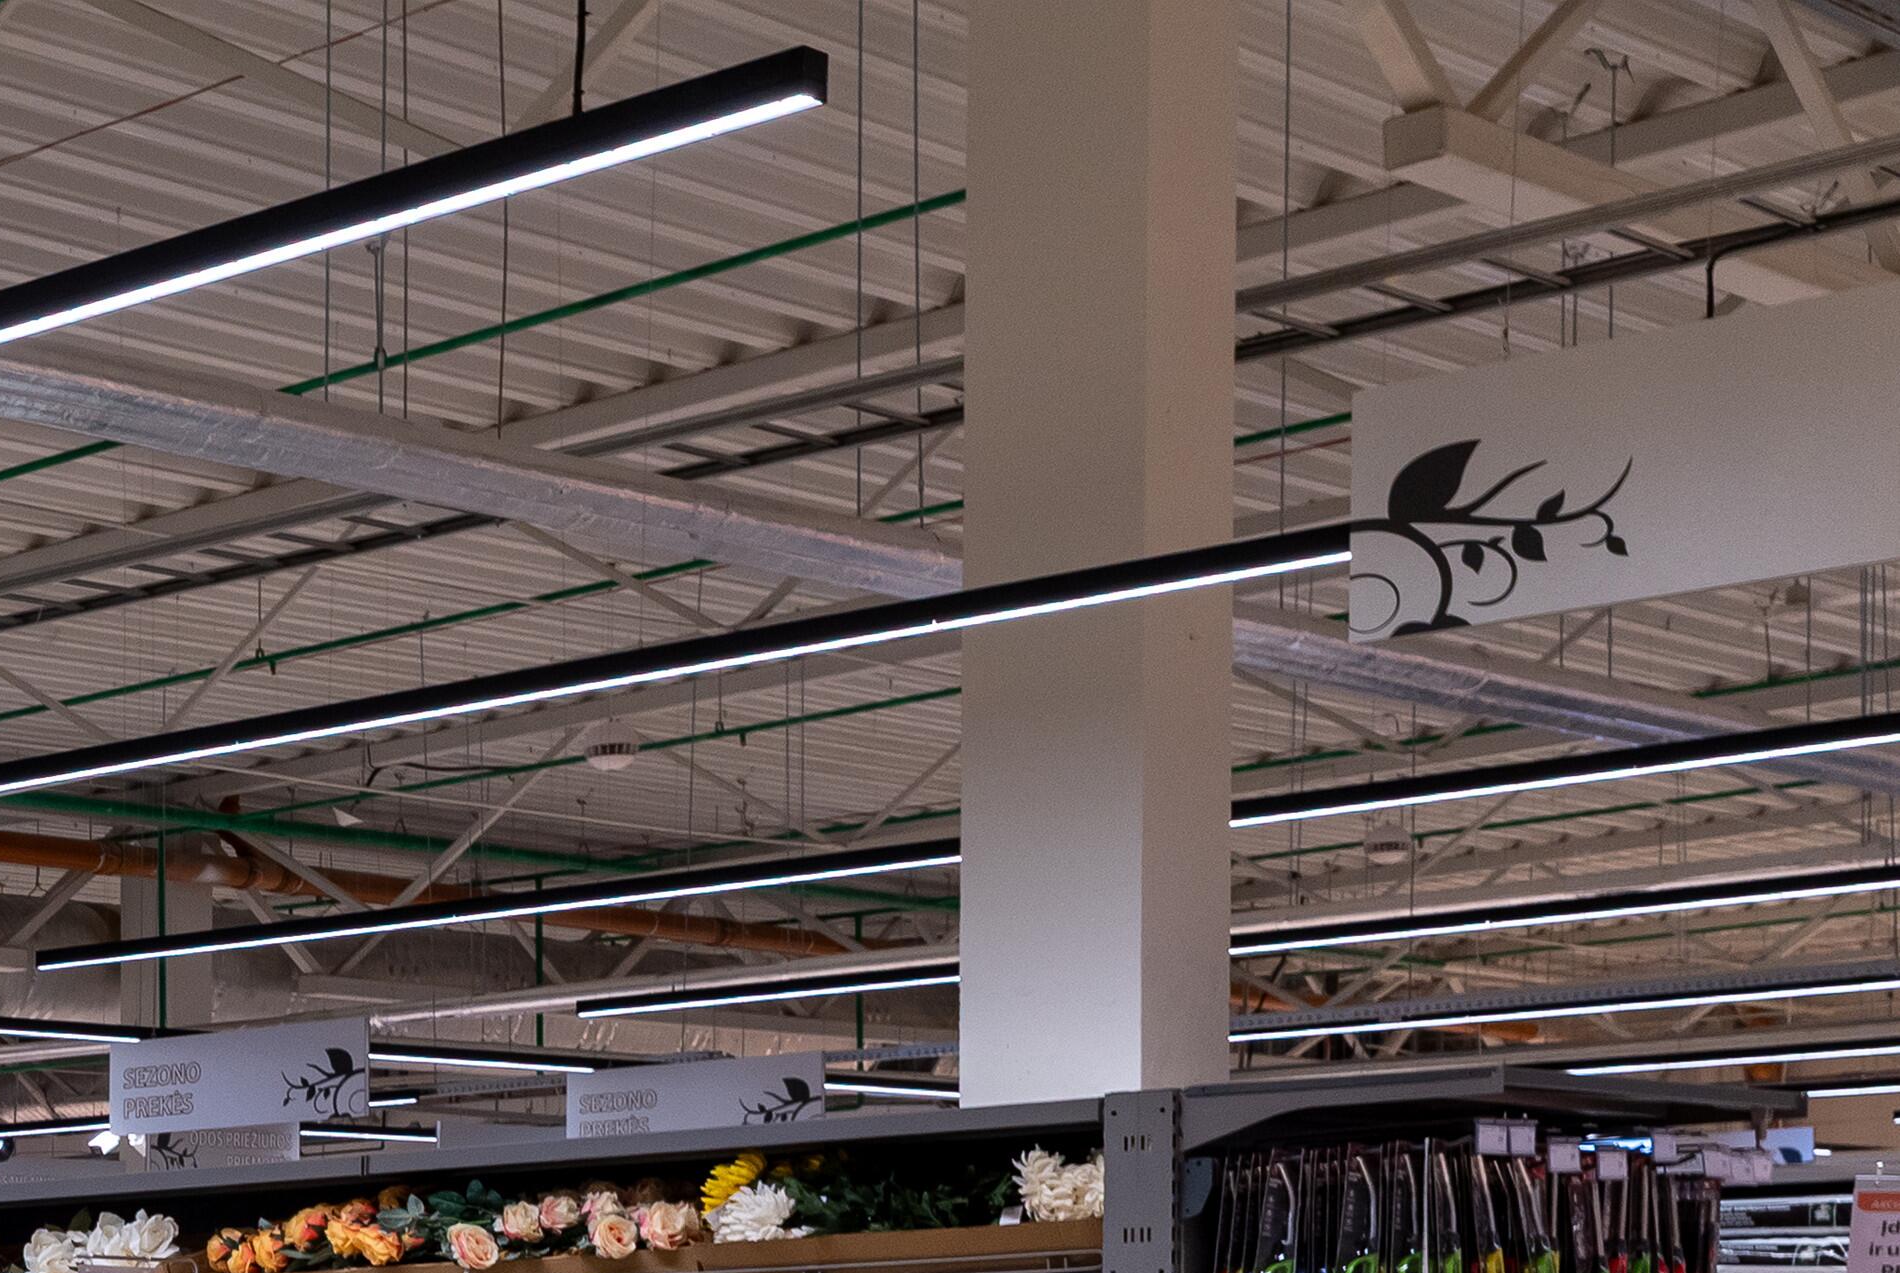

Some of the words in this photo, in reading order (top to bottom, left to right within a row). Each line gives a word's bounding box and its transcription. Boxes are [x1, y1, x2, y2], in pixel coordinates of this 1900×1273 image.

[122, 1061, 201, 1090] SEZONO
[123, 1090, 194, 1120] PREKĖS
[578, 1089, 658, 1114] SEZONO
